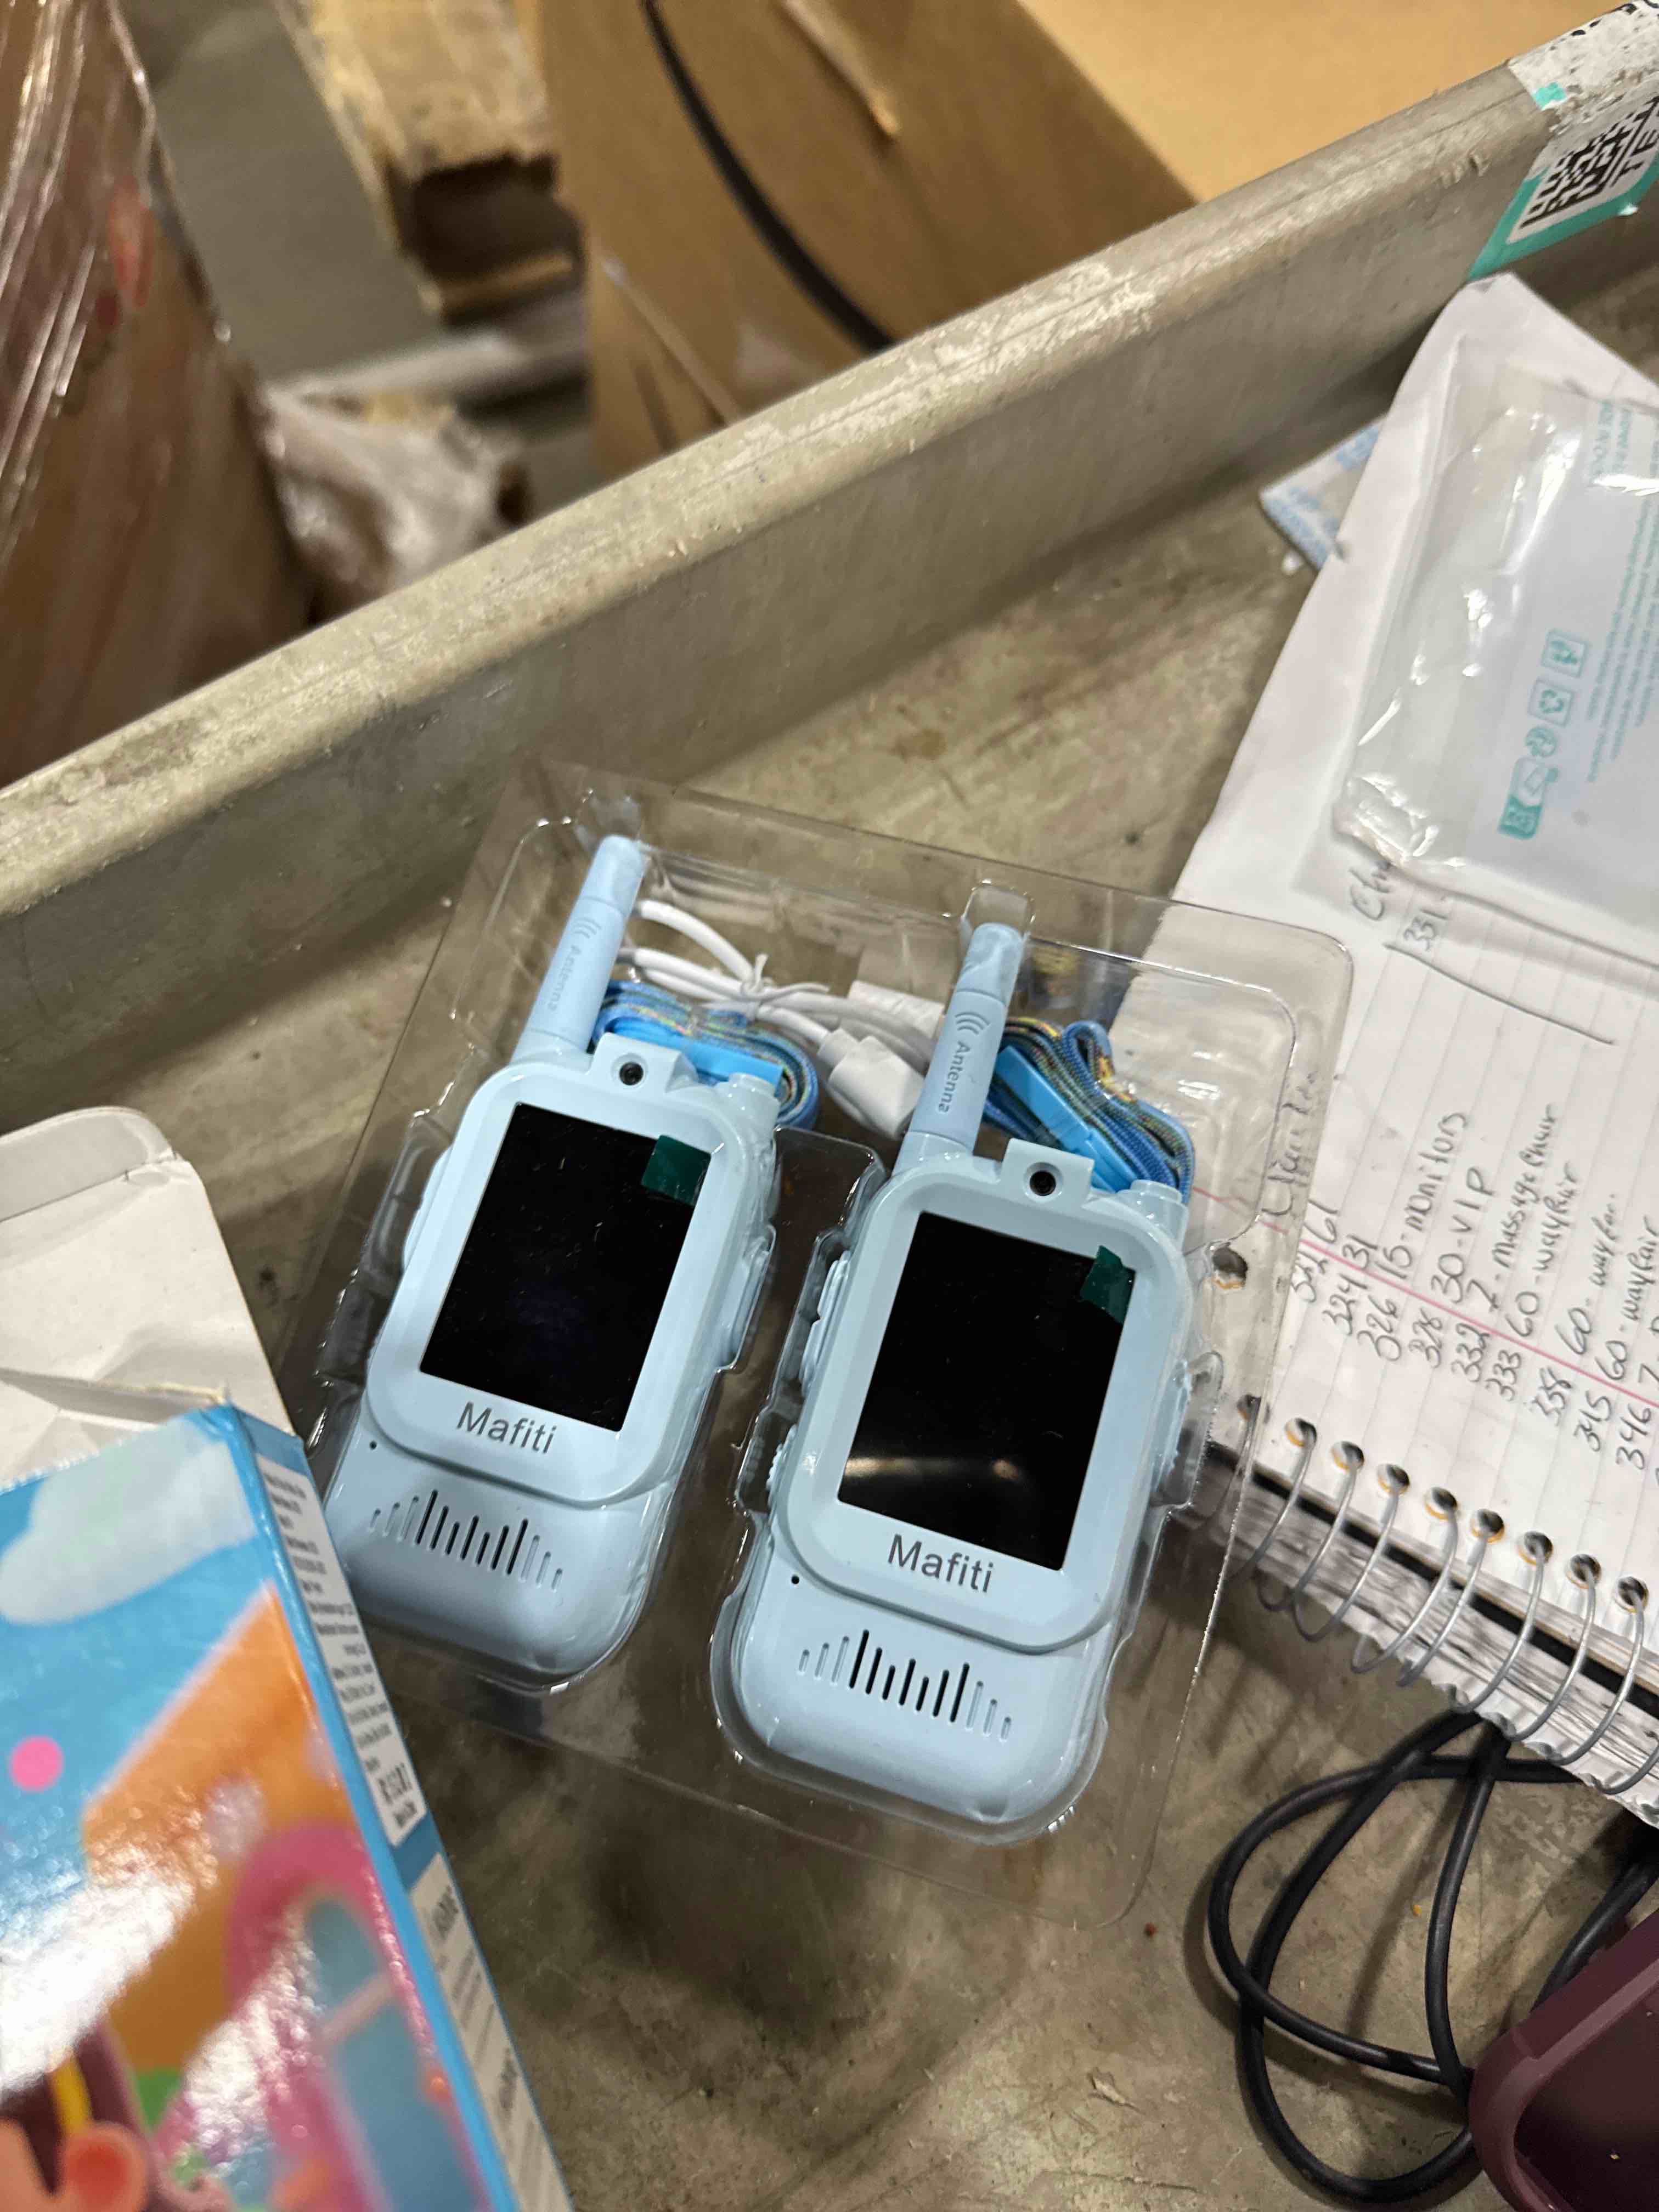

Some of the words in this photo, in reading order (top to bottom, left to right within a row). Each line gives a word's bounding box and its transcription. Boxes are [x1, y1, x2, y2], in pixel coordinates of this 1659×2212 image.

[548, 944, 582, 1012] Antenna
[938, 1041, 971, 1113] Antenna
[1484, 1349, 1522, 1402] 333
[456, 1401, 557, 1454] Mafiti
[1615, 1403, 1652, 1470] 346
[887, 1533, 994, 1593] Mafiti
